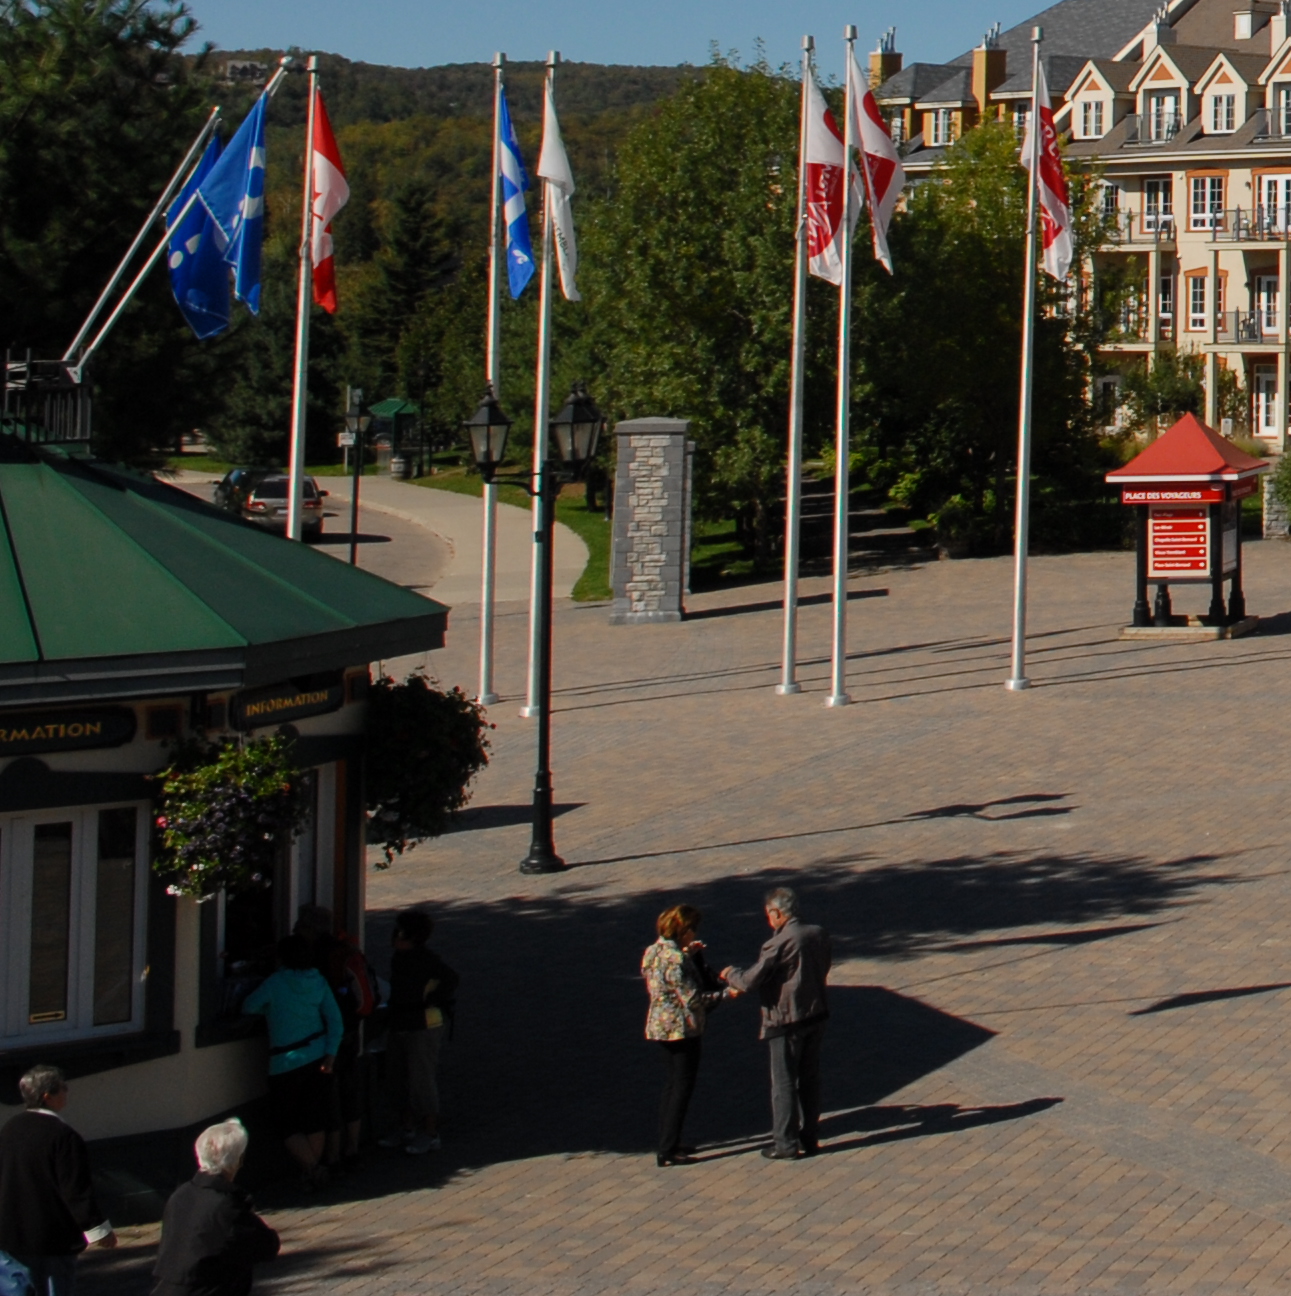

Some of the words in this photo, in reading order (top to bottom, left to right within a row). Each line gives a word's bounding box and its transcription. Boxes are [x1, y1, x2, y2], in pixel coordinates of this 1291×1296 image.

[1125, 492, 1146, 500] PLACE
[1161, 491, 1202, 499] VOYAGEURS
[246, 690, 328, 717] INFORMATION
